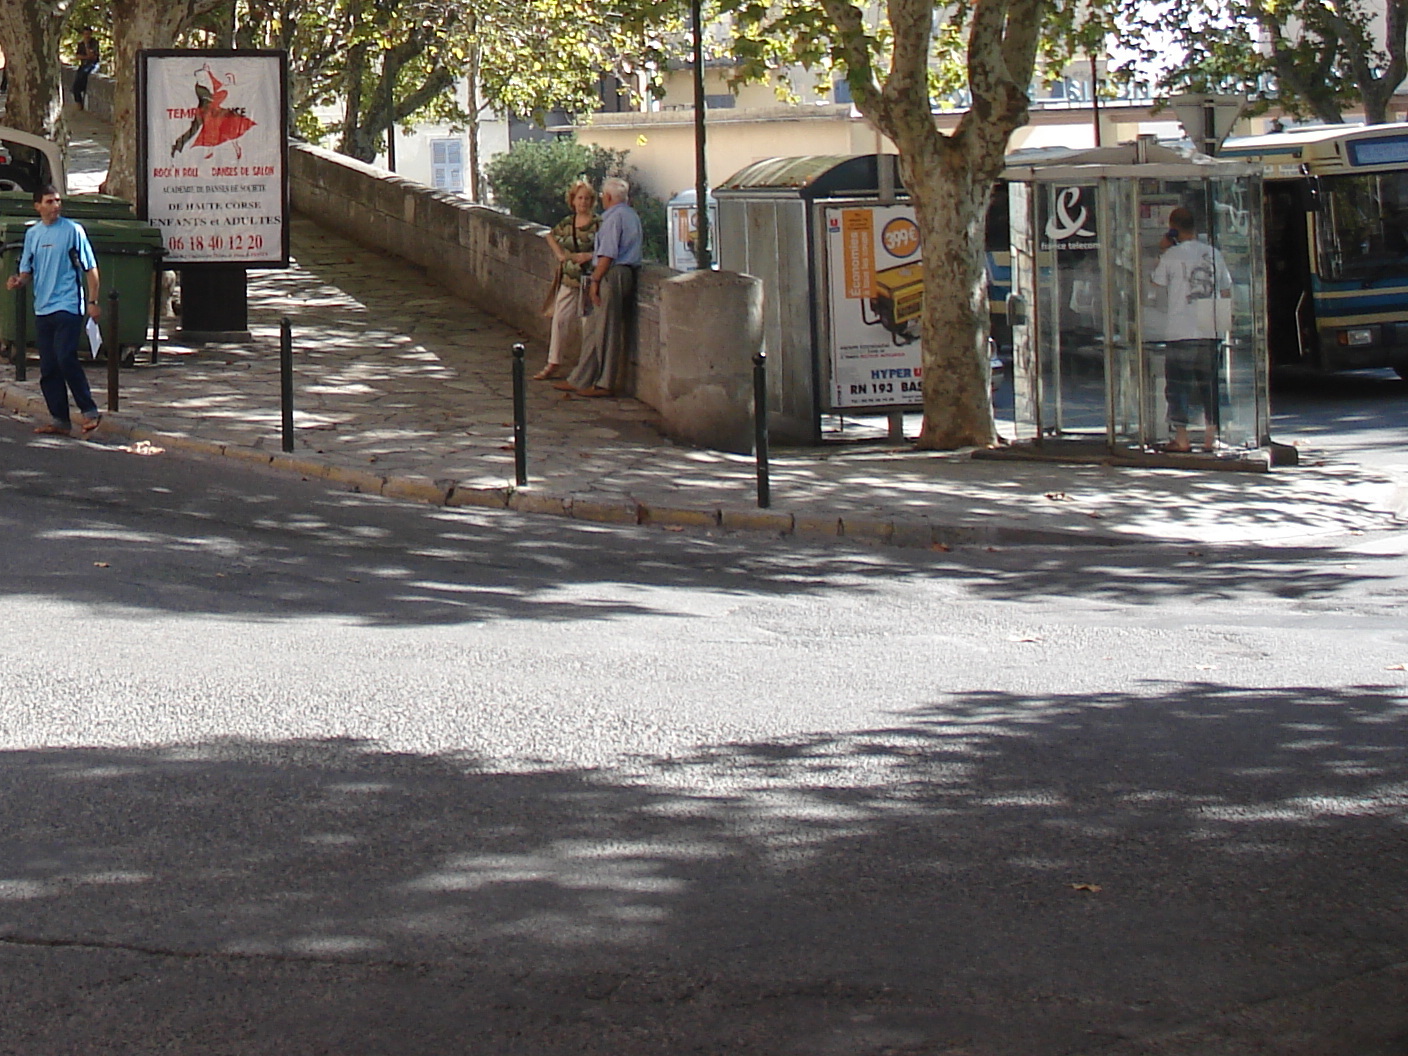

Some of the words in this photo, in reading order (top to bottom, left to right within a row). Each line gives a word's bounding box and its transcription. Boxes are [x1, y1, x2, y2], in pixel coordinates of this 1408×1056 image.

[211, 166, 238, 177] DANSES
[240, 166, 250, 176] DE
[252, 165, 275, 176] SALON
[168, 203, 183, 211] DE
[186, 202, 223, 211] HAUTE
[225, 201, 262, 210] CORSE
[149, 217, 207, 227] ENFANTS
[210, 217, 220, 225] et
[223, 215, 281, 225] ADULTES
[168, 236, 185, 252] 06
[189, 235, 204, 251] 18
[208, 235, 223, 251] 40
[228, 234, 243, 250] 12
[247, 234, 264, 250] 20
[871, 368, 912, 380] HYPER
[850, 384, 867, 395] RN
[872, 382, 893, 394] 193
